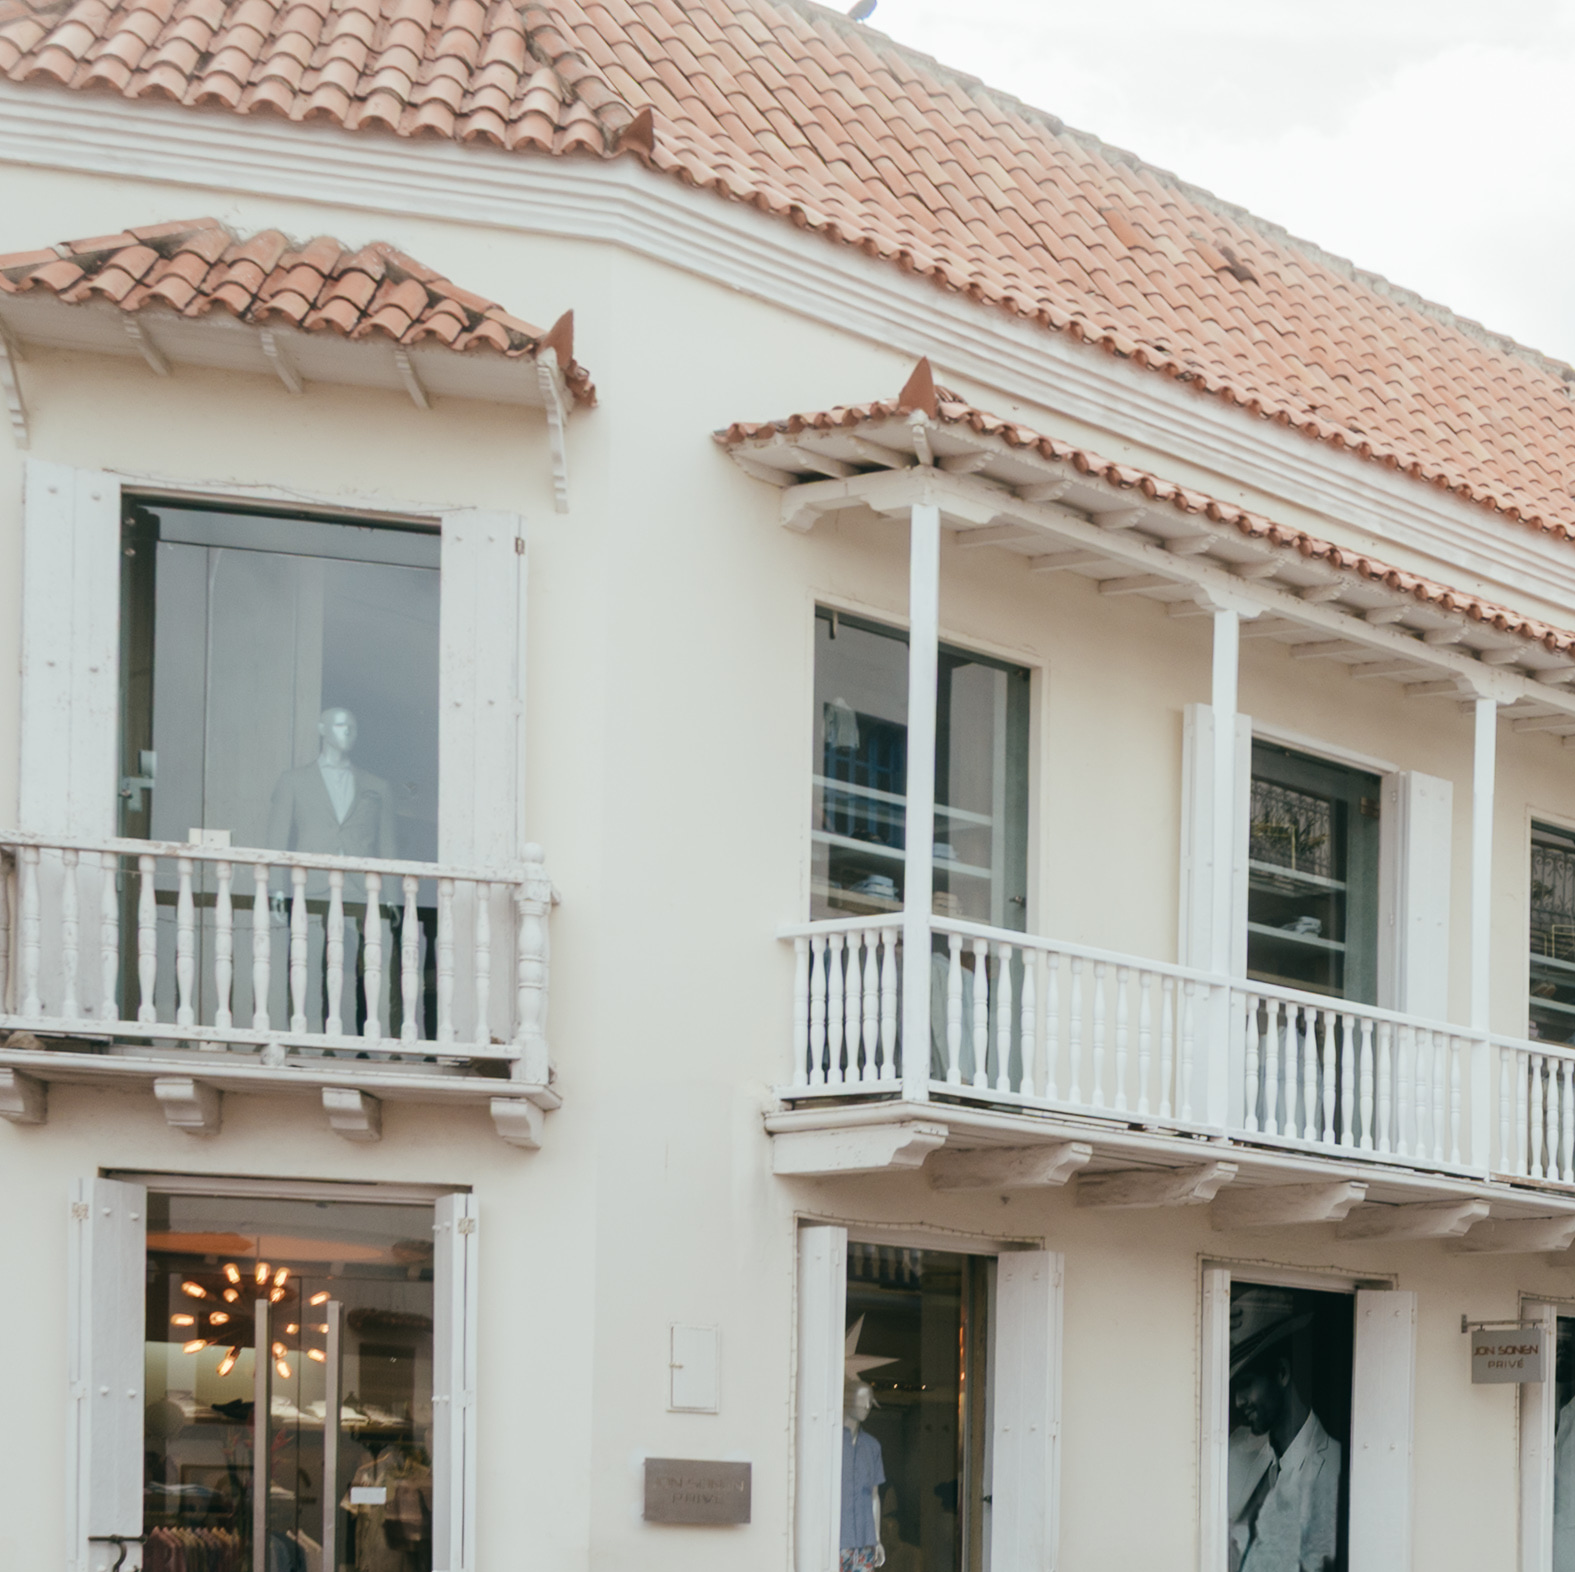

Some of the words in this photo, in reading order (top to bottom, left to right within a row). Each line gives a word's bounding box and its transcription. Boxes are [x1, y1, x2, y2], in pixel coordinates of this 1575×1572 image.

[1474, 1345, 1495, 1356] JON
[1498, 1344, 1539, 1355] SONEN
[1487, 1357, 1525, 1369] PRIVÉ
